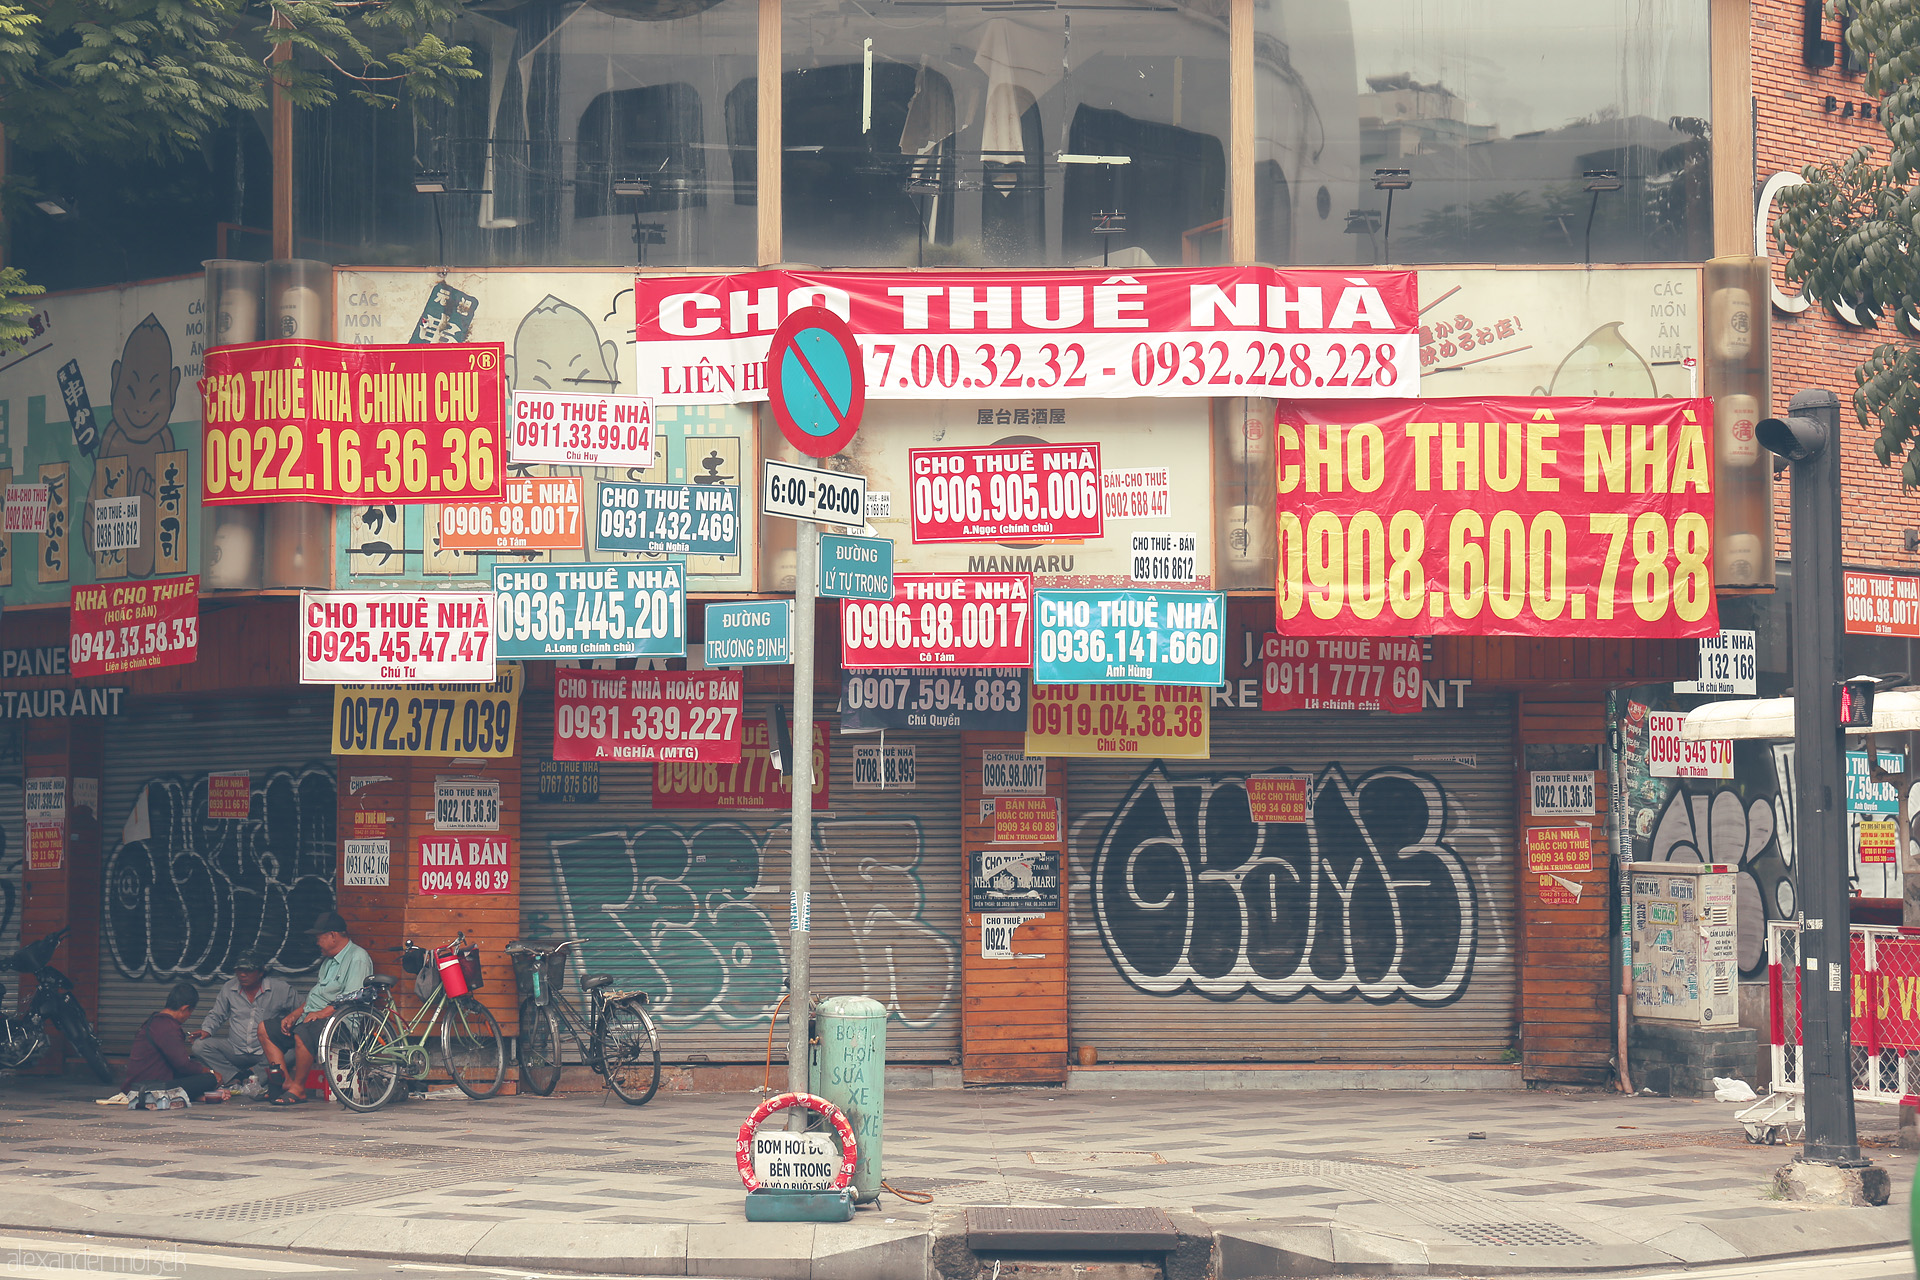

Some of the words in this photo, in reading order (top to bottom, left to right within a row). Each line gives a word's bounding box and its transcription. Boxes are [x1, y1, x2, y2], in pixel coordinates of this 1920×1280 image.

[348, 290, 379, 307] CÁC
[1653, 281, 1683, 296] CÁC
[658, 286, 850, 336] CHO
[888, 276, 1149, 330] THUÊ
[1189, 277, 1396, 330] NHÀ
[345, 311, 382, 327] MÓN
[1658, 322, 1680, 338] ĂN
[661, 357, 736, 395] LIÊN
[742, 352, 769, 391] H
[1131, 340, 1398, 388] 0932.228.228
[205, 372, 246, 424] CHO
[251, 357, 306, 421] THUÊ
[311, 361, 352, 423] NHÀ
[358, 362, 428, 423] CHÍNH
[434, 353, 479, 423] CHỦ
[517, 400, 554, 420] CHO
[561, 399, 608, 423] THUÊ
[614, 400, 651, 424] NHÀ
[977, 408, 1066, 425] 屋台居酒屋
[516, 421, 650, 451] 0911.33.99.04
[206, 424, 494, 494] 0922.16.36.36
[914, 455, 965, 475] CHO
[972, 450, 1035, 473] THUÊ
[1043, 448, 1095, 471] NHÀ
[1276, 423, 1385, 494] CHO
[1405, 408, 1560, 493] THUÊ
[1583, 409, 1711, 494] NHÀ
[602, 487, 639, 508] CHO
[645, 486, 690, 510] THUÊ
[695, 488, 734, 512] NHÀ
[916, 471, 1097, 524] 0906.905.006
[96, 506, 107, 521] CHO
[108, 503, 122, 520] THUÊ
[127, 502, 138, 518] BÁN
[443, 505, 579, 536] 0906.98.0017
[96, 524, 111, 548] 0936
[113, 522, 124, 546] 168
[125, 521, 138, 545] 612
[600, 508, 734, 542] 0931.432.469
[836, 543, 878, 563] ĐƯỜNG
[1133, 536, 1149, 551] CHO
[1151, 533, 1171, 551] THUÊ
[1179, 533, 1195, 551] BÁN
[968, 555, 1074, 573] MANMARU
[1134, 556, 1150, 579] 093
[1153, 556, 1169, 579] 616
[1172, 556, 1193, 579] 8612
[1278, 508, 1711, 623] 0908.600.788
[496, 572, 548, 591] CHO
[555, 568, 619, 590] THUÊ
[627, 567, 681, 589] NHÀ
[825, 567, 836, 590] LÝ
[839, 572, 853, 595] TỰ
[854, 574, 888, 597] TRỌNG
[904, 578, 972, 600] THUÊ
[975, 578, 1027, 600] NHÀ
[1846, 577, 1868, 595] CHO
[1869, 577, 1895, 597] THUÊ
[1896, 578, 1918, 599] NHÀ
[75, 585, 108, 611] NHÀ
[113, 586, 147, 606] CHO
[153, 577, 195, 602] THUÊ
[104, 610, 134, 625] (HOẶC
[135, 604, 157, 619] BÁN)
[307, 602, 358, 629] CHO
[366, 597, 429, 629] THUÊ
[438, 597, 489, 629] NHÀ
[498, 589, 681, 642] 0936.445.201
[722, 611, 771, 628] ĐƯỜNG
[1040, 600, 1090, 628] CHO
[1097, 595, 1159, 628] THUÊ
[1166, 597, 1219, 630] NHÀ
[1847, 596, 1918, 625] 0906.98.0017
[846, 602, 1028, 649] 0906.98.0017
[72, 617, 197, 664] 0942.33.58.33
[307, 630, 489, 662] 0925.45.47.47
[708, 639, 754, 660] TRƯƠNG
[757, 637, 786, 661] ĐỊNH
[1040, 629, 1218, 665] 0936.141.660
[1265, 638, 1309, 658] CHO
[1316, 637, 1371, 660] THUÊ
[1378, 639, 1421, 662] NHÀ
[919, 652, 933, 662] Cô
[934, 652, 955, 662] Tám
[1707, 653, 1730, 680] 132
[1733, 653, 1754, 681] 168
[558, 678, 587, 700] CHO
[591, 677, 627, 700] THUÊ
[631, 677, 660, 700] NHÀ
[665, 677, 705, 705] HOẶC
[709, 677, 739, 701] BÁN
[1266, 661, 1319, 695] 0911
[1329, 664, 1385, 697] 7777
[1393, 666, 1421, 699] 69
[848, 678, 1021, 712] 0907.594.883
[339, 696, 511, 752] 0972.377.039
[558, 704, 738, 741] 0931.339.227
[1032, 702, 1203, 738] 0919.04.38.38
[1651, 717, 1673, 732] CHO
[1097, 738, 1116, 751] Chú
[1119, 738, 1138, 751] Sơn
[1651, 735, 1680, 762] 0909
[1710, 739, 1732, 765] 670
[855, 758, 915, 783] 0708.88.993
[984, 763, 1044, 787] 0906.98.0017
[1536, 775, 1550, 783] CHO
[1552, 774, 1571, 783] THUÊ
[1573, 774, 1588, 783] NHÀ
[439, 788, 454, 797] CHO
[457, 788, 475, 797] THUÊ
[477, 787, 493, 797] NHÀ
[1005, 798, 1025, 810] BÁN
[1028, 798, 1046, 810] NHÀ
[1535, 785, 1593, 808] 0922.16.36.36
[438, 799, 497, 822] 0922.16.36.36
[1530, 841, 1551, 852] HOẶC
[1552, 841, 1568, 850] CHO
[1570, 838, 1590, 849] THUÊ
[1538, 829, 1558, 841] BÁN
[1560, 828, 1580, 840] NHÀ
[422, 838, 464, 866] NHÀ
[468, 837, 507, 865] BÁN
[1531, 853, 1551, 862] 0909
[1553, 852, 1564, 862] 34
[1566, 851, 1577, 861] 60
[1579, 851, 1589, 861] 89
[346, 855, 361, 874] 0931
[363, 855, 375, 874] 642
[377, 855, 389, 875] 166
[848, 1087, 870, 1106] XE
[770, 1158, 791, 1177] BÊN
[793, 1162, 832, 1177] TRONG
